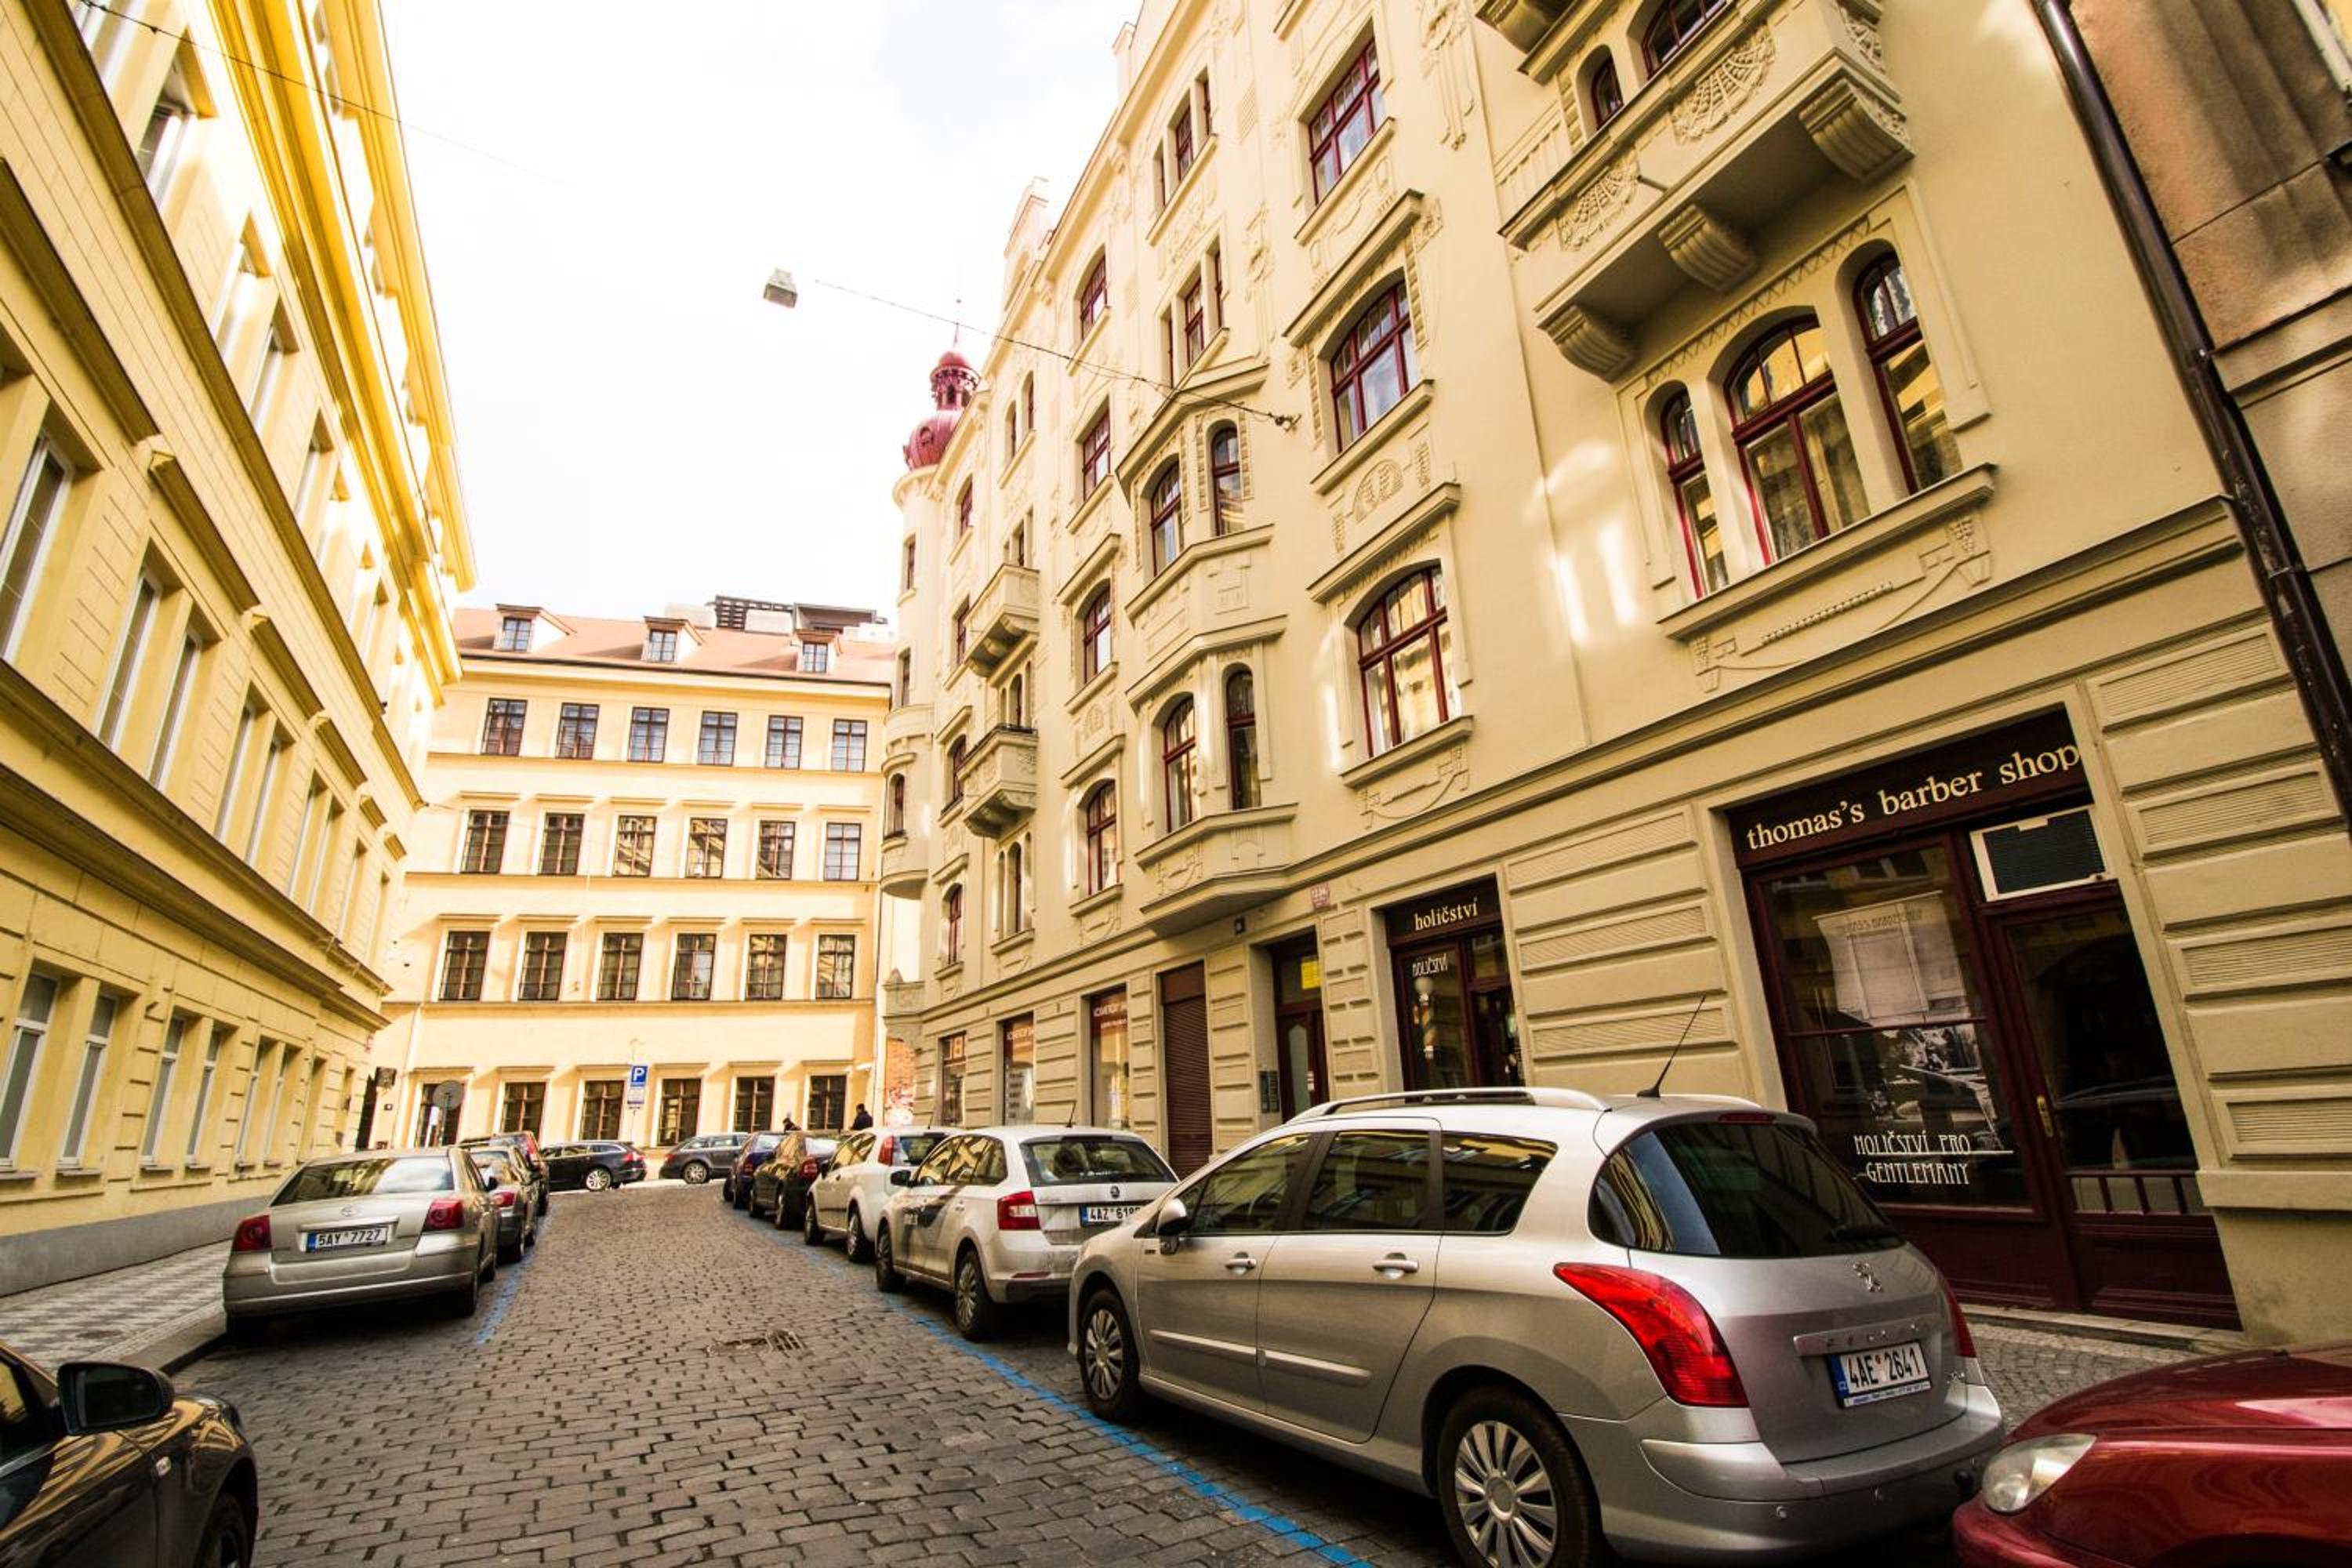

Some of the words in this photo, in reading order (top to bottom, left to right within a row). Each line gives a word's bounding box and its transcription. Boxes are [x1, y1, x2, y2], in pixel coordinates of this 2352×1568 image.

[1747, 800, 1865, 851] thomas's
[1878, 770, 1984, 816] barber
[1998, 745, 2080, 785] shop
[1414, 896, 1479, 931] holičství
[633, 1067, 645, 1082] P
[1853, 1130, 1930, 1156] HOLIČSTVÍ
[1938, 1134, 1971, 1156] PRO
[1865, 1162, 1970, 1185] GENTLEMANY
[1090, 1207, 1109, 1221] 4AZ
[318, 1234, 341, 1246] 5AY
[350, 1229, 381, 1243] 7727
[1848, 1356, 1878, 1388] 4AE
[1885, 1348, 1920, 1380] 2641
